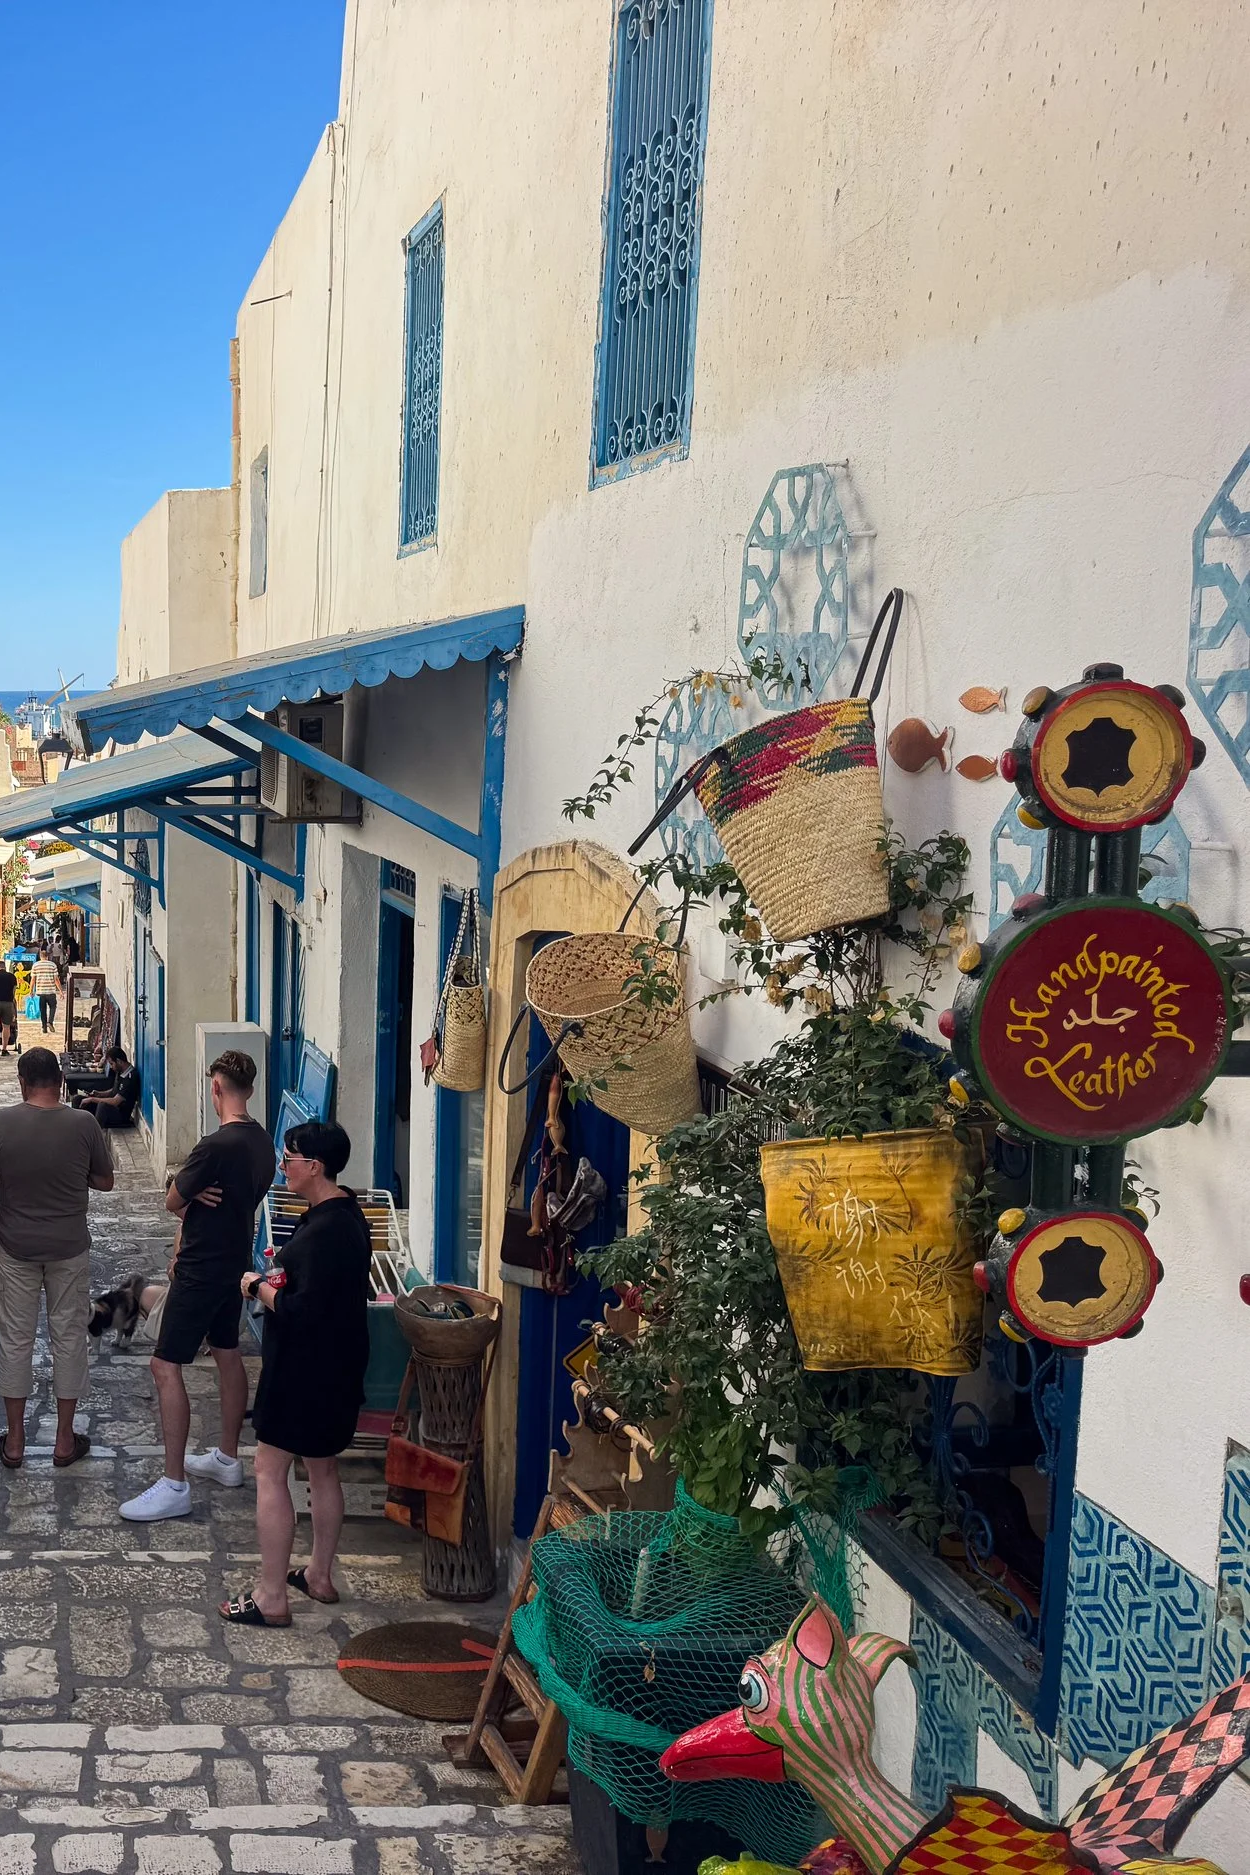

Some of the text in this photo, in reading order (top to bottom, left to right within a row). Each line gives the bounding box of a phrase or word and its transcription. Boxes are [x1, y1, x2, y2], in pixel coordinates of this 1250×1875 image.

[1005, 933, 1195, 1054] Handpainted
[1062, 993, 1139, 1034] جلد
[1023, 1042, 1159, 1112] Leather
